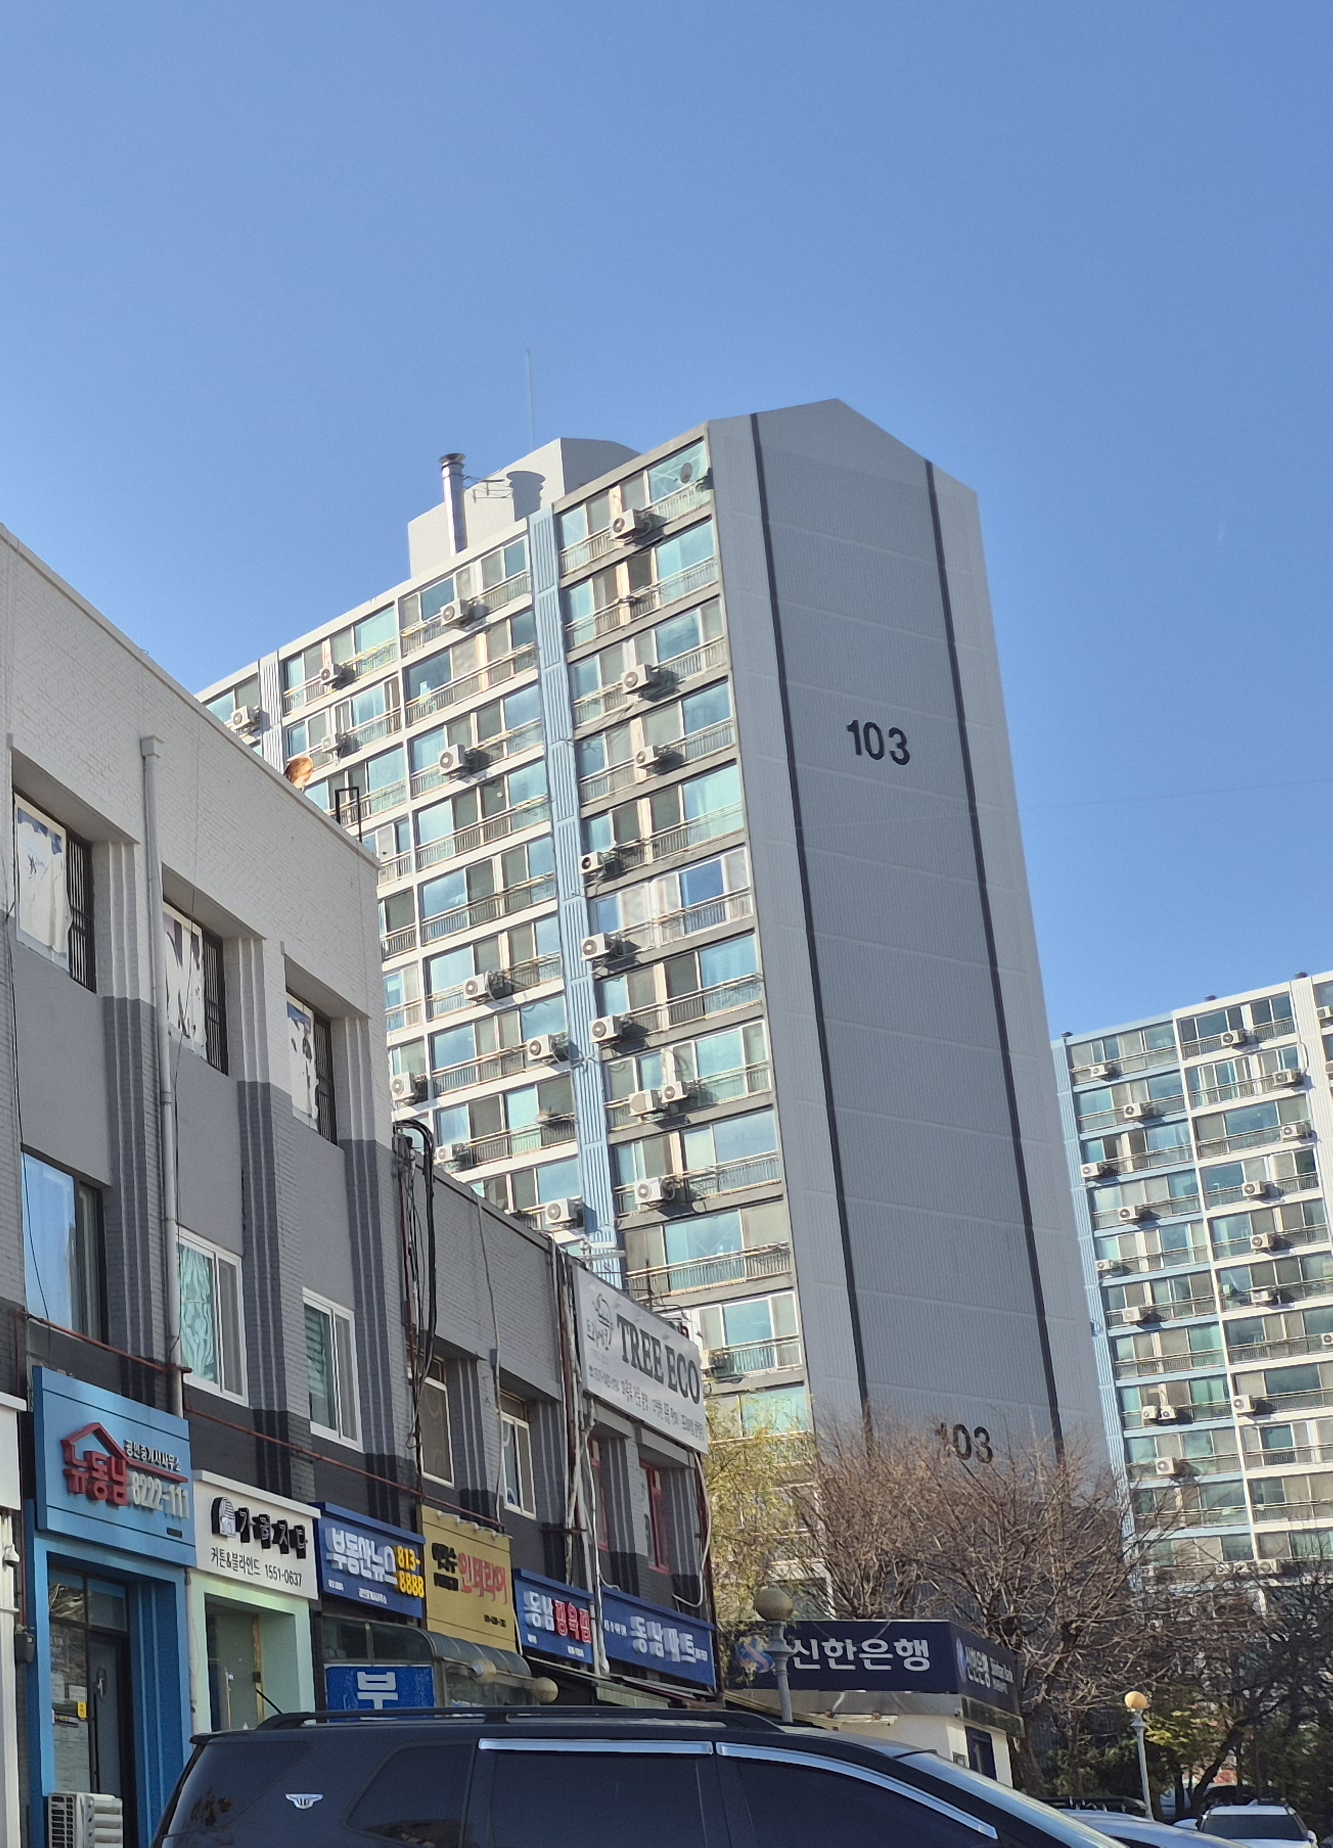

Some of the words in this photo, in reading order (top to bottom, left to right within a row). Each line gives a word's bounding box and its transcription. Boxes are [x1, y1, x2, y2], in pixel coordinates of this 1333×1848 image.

[846, 719, 911, 766] 103
[616, 1312, 665, 1386] TREE
[665, 1344, 701, 1405] ECO
[934, 1421, 994, 1465] 103
[789, 1637, 931, 1672] 신한은행
